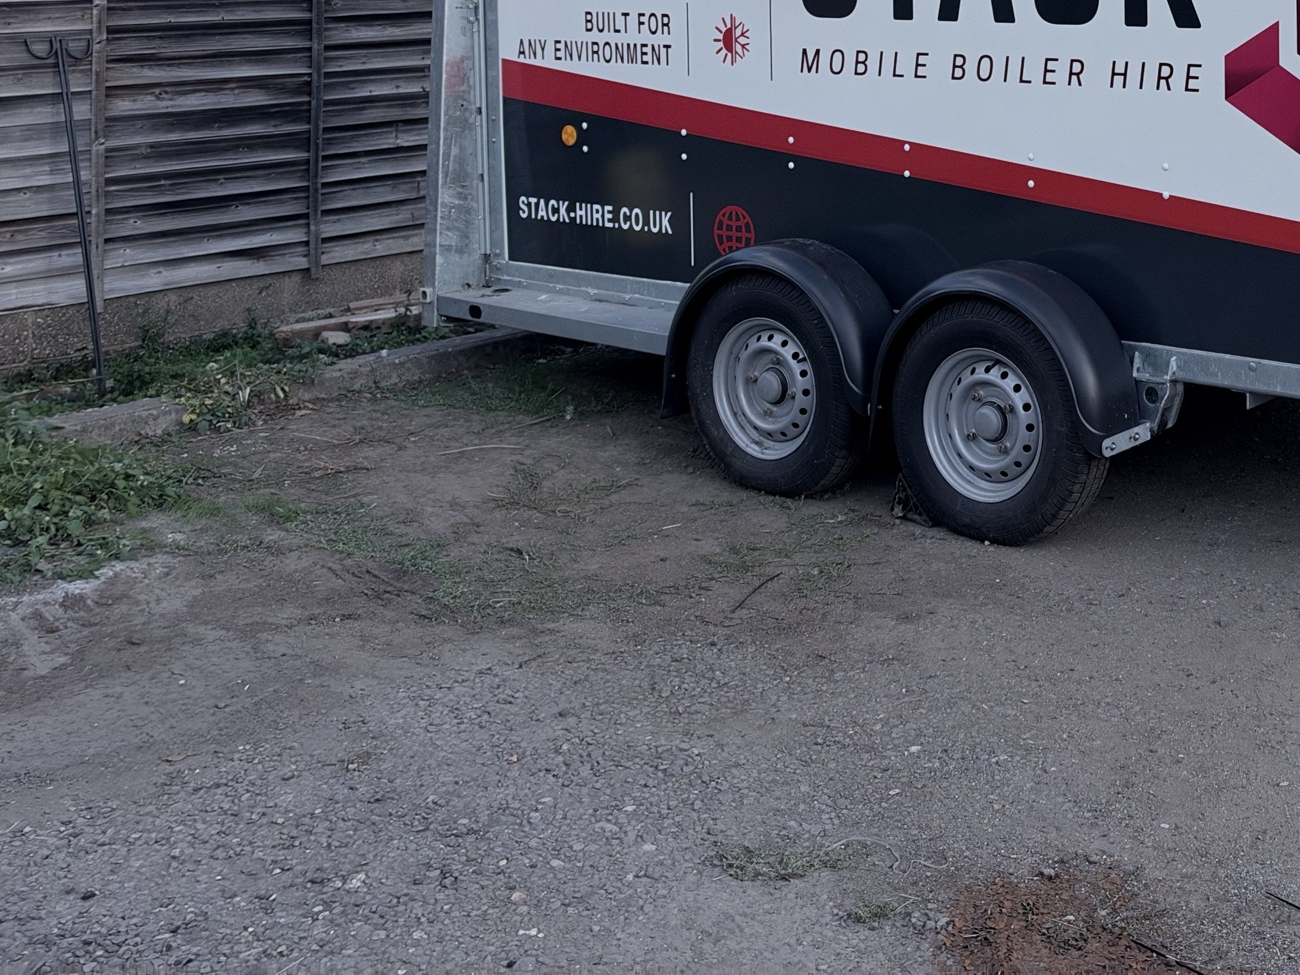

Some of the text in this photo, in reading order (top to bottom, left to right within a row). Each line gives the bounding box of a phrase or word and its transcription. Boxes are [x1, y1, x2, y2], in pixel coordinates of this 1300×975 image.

[584, 11, 671, 36] BUILT FOR
[517, 38, 672, 66] ANY ENVIRONMENT
[799, 47, 1203, 93] MOBILE BOILER HIRE
[518, 195, 673, 235] STACK-HIRE.CO.UK
